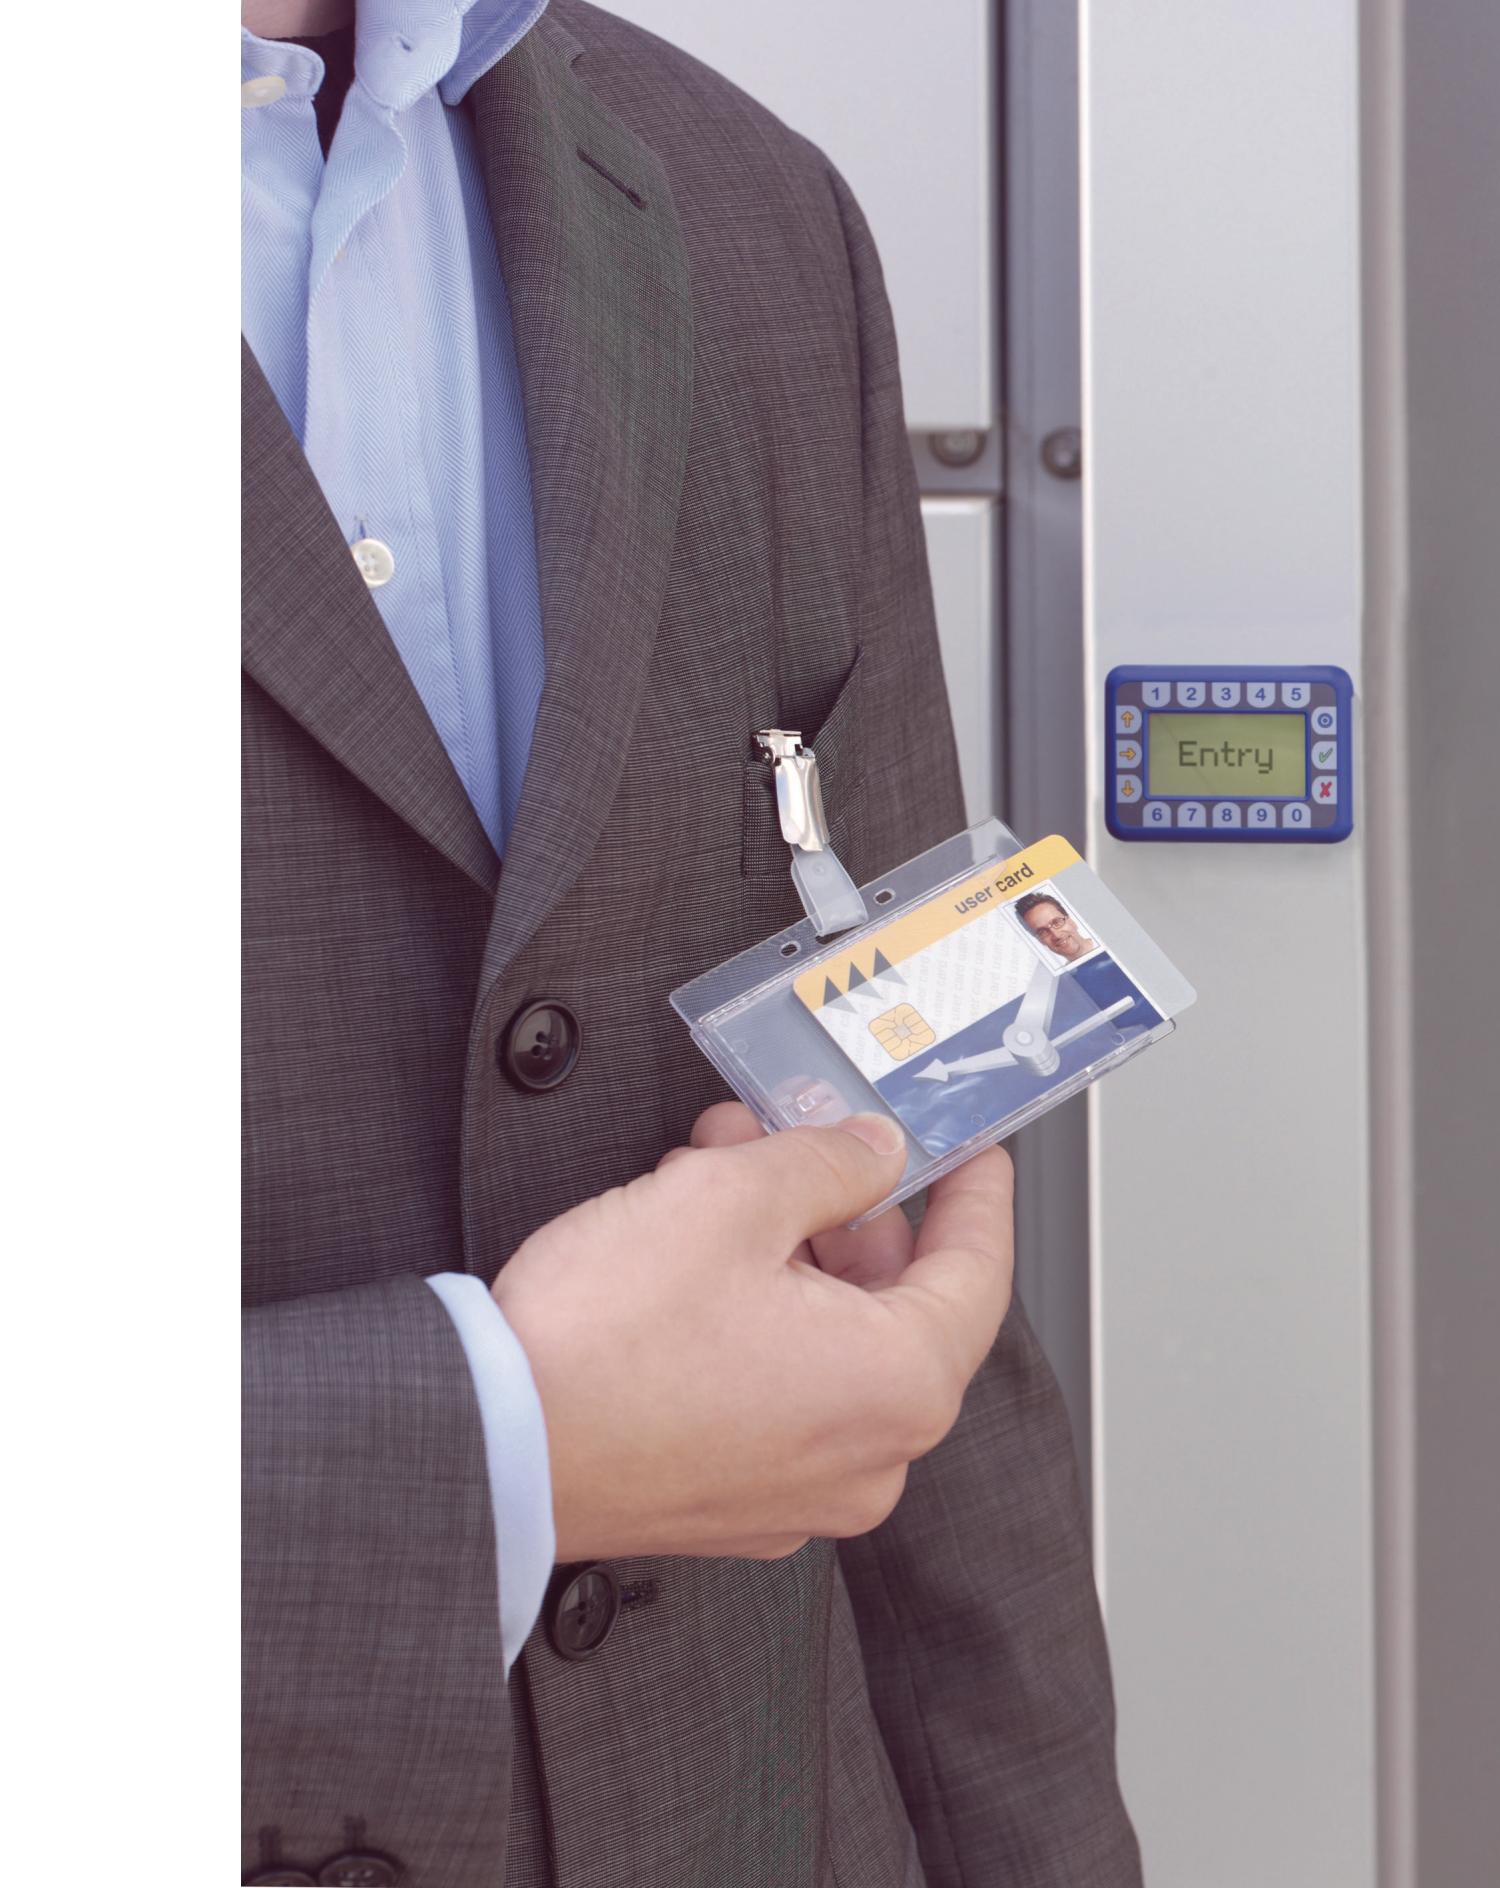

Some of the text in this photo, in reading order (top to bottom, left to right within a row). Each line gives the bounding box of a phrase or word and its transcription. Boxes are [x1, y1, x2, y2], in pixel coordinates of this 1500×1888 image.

[1151, 687, 1302, 702] 1 2 3 4 5
[1178, 740, 1274, 775] Entry
[1151, 808, 1303, 823] 6 7 8 9 0
[954, 862, 1034, 914] user card
